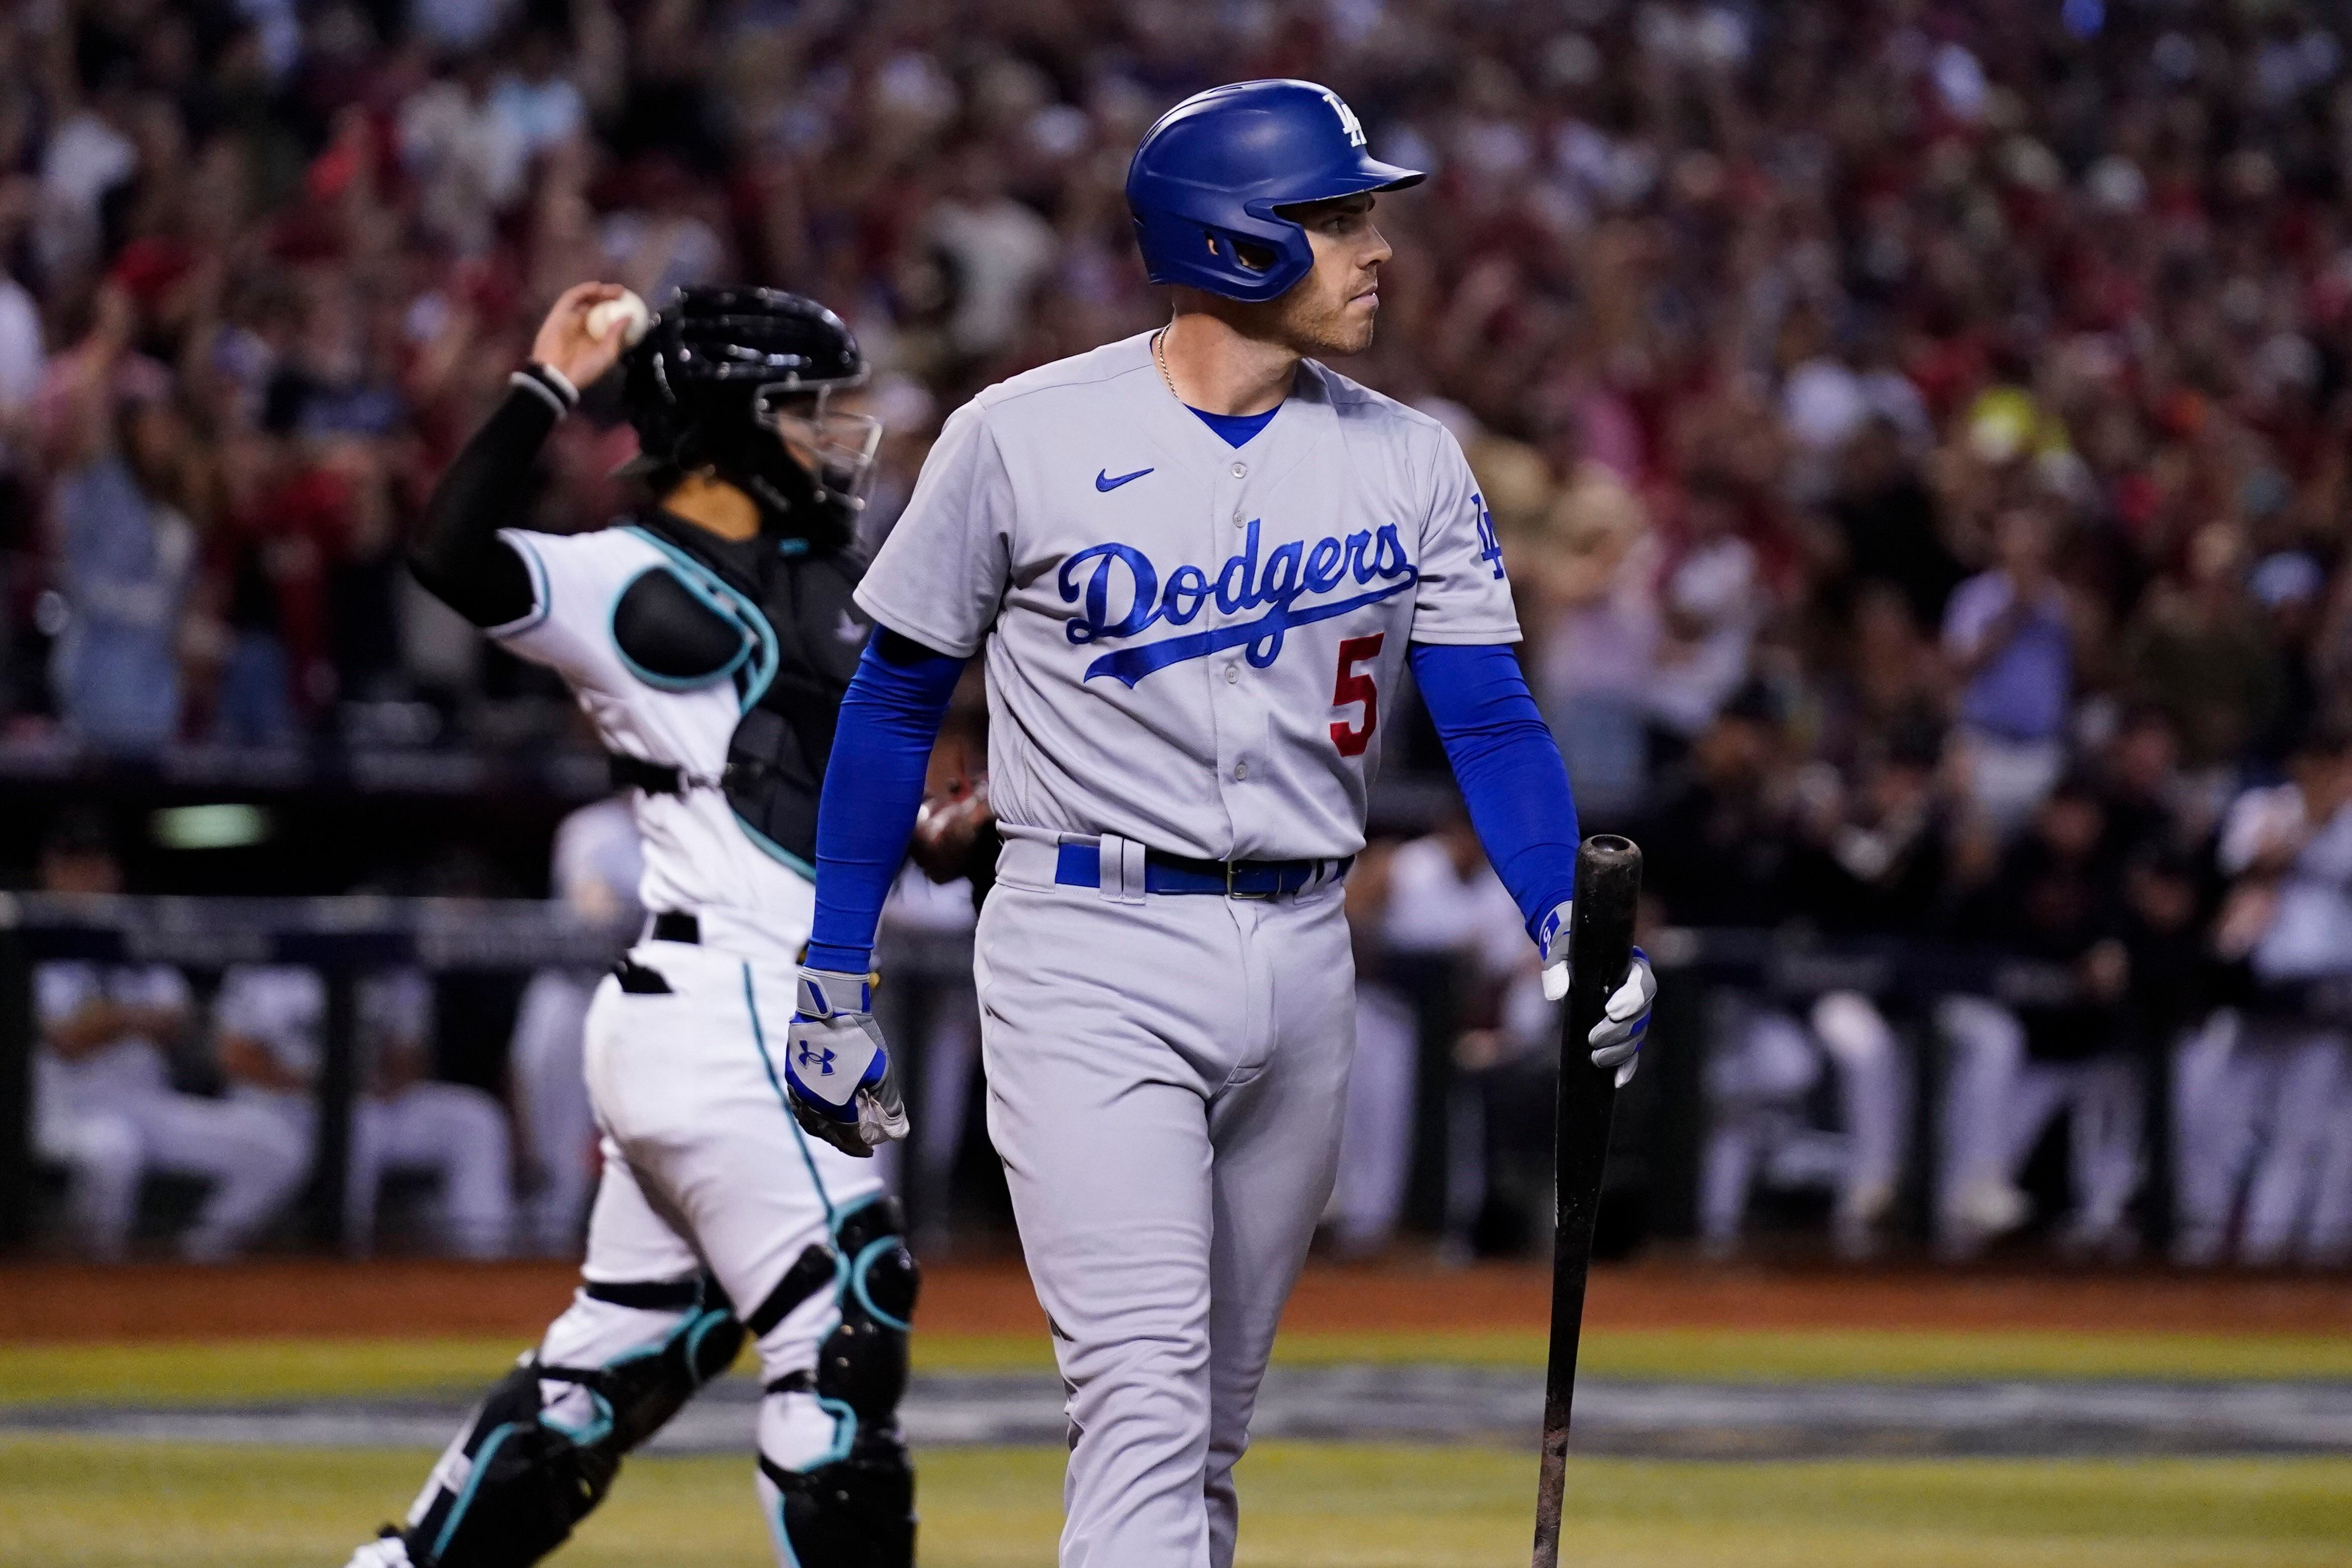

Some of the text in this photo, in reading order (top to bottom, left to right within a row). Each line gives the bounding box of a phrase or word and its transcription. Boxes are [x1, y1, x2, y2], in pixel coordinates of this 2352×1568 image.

[1322, 92, 1367, 147] LA
[1059, 518, 1416, 669] Dodgers
[1330, 632, 1385, 758] 5
